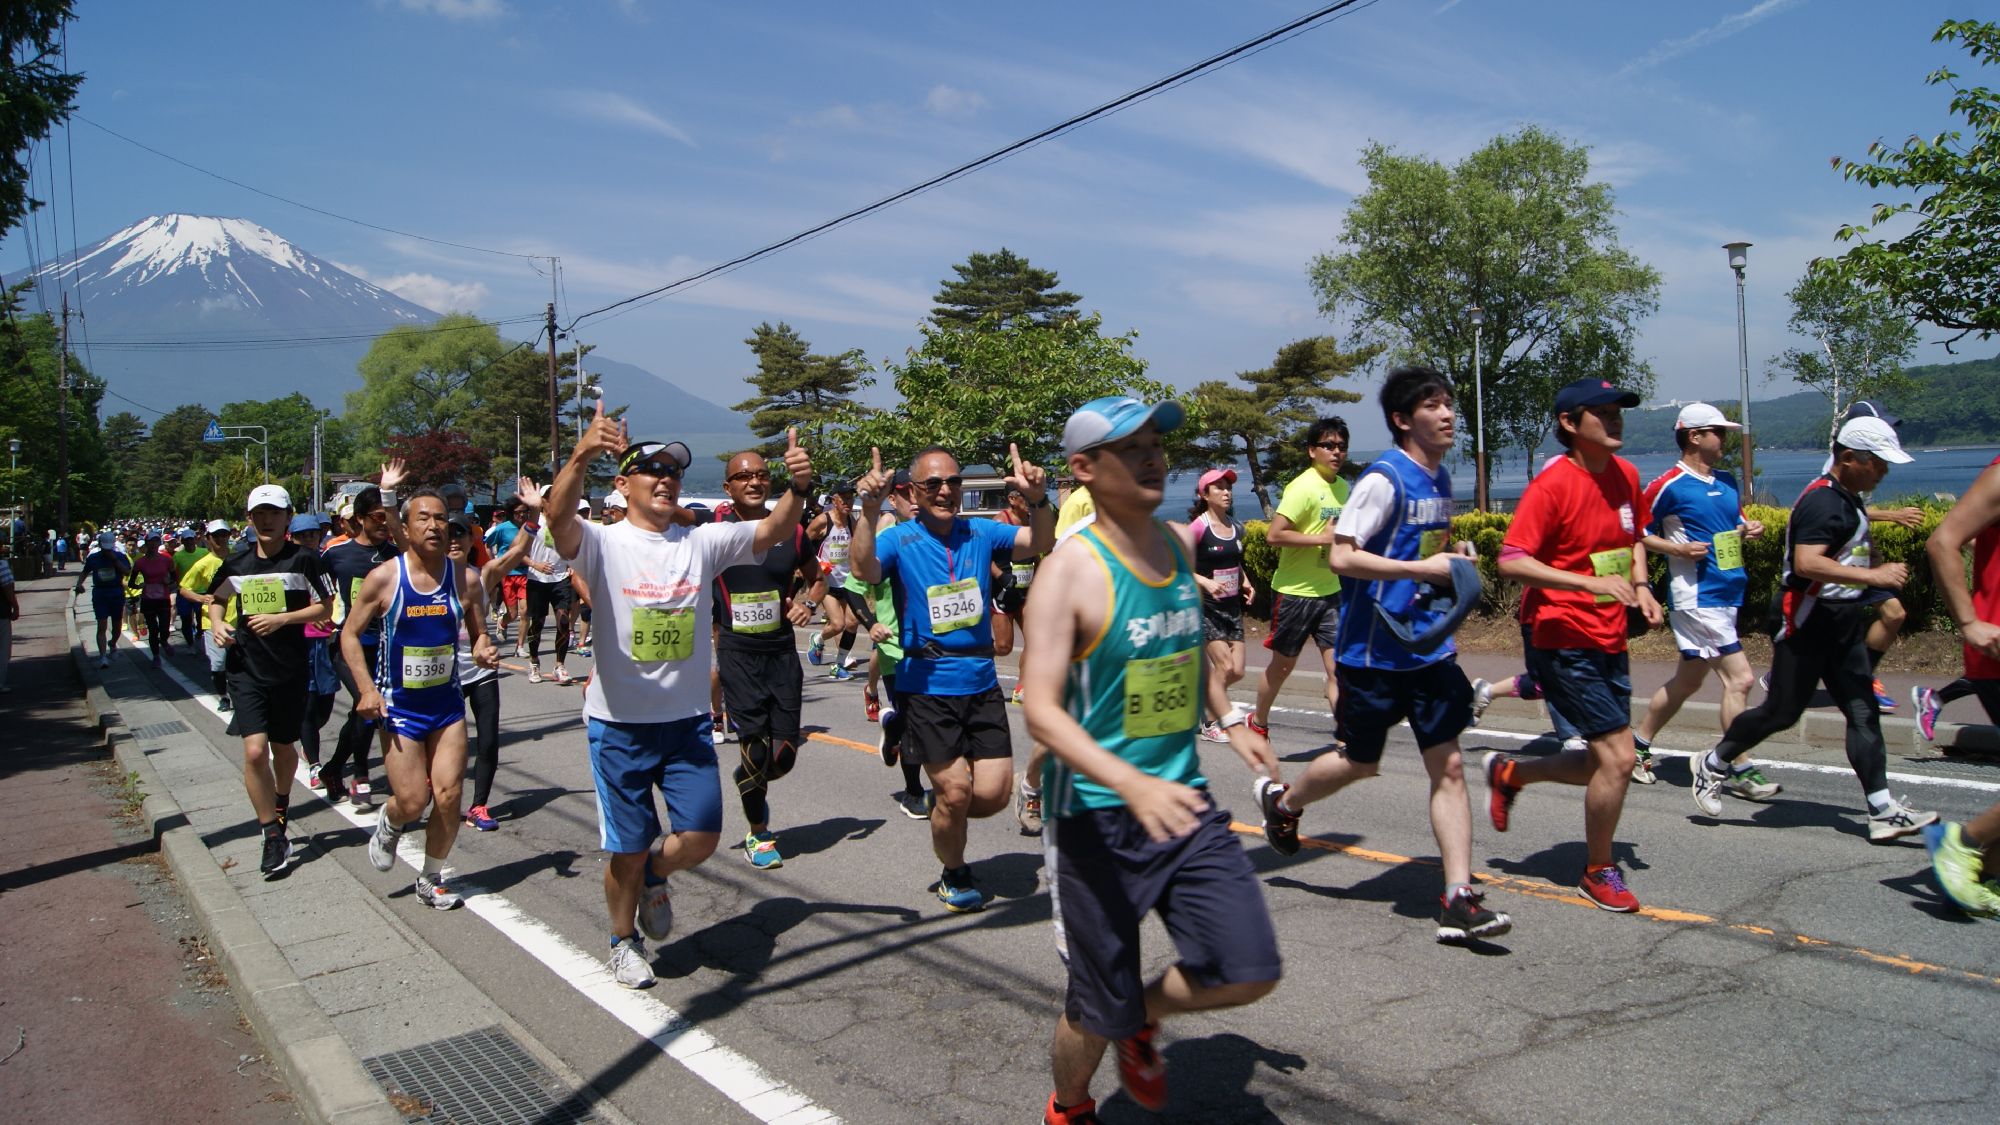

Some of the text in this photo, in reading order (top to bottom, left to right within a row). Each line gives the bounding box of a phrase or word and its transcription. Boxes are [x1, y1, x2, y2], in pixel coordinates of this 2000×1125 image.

[243, 592, 277, 604] C 1028
[735, 608, 773, 622] B 5368
[932, 598, 976, 619] B 5246
[634, 629, 681, 646] B 502
[404, 663, 446, 677] B 5398
[1129, 685, 1188, 715] B 868
